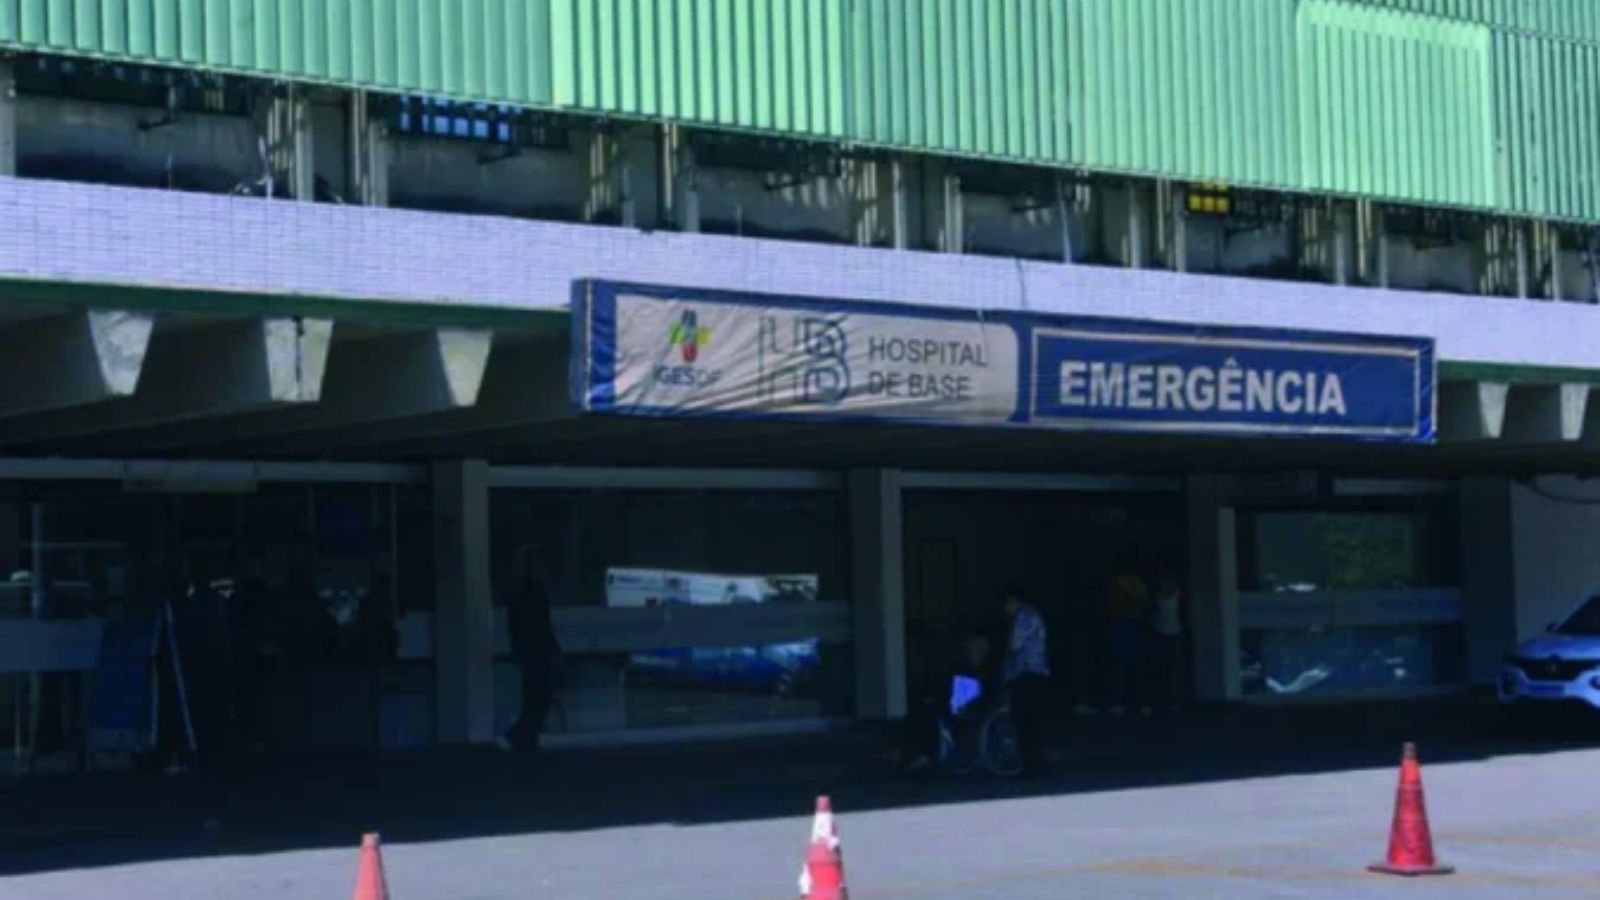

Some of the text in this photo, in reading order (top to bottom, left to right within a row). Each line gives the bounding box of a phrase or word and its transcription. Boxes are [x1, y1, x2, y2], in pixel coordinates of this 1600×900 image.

[868, 337, 988, 367] HOSPITAL
[867, 371, 971, 398] DE BASE
[1060, 357, 1347, 415] EMERGÊNCIA
